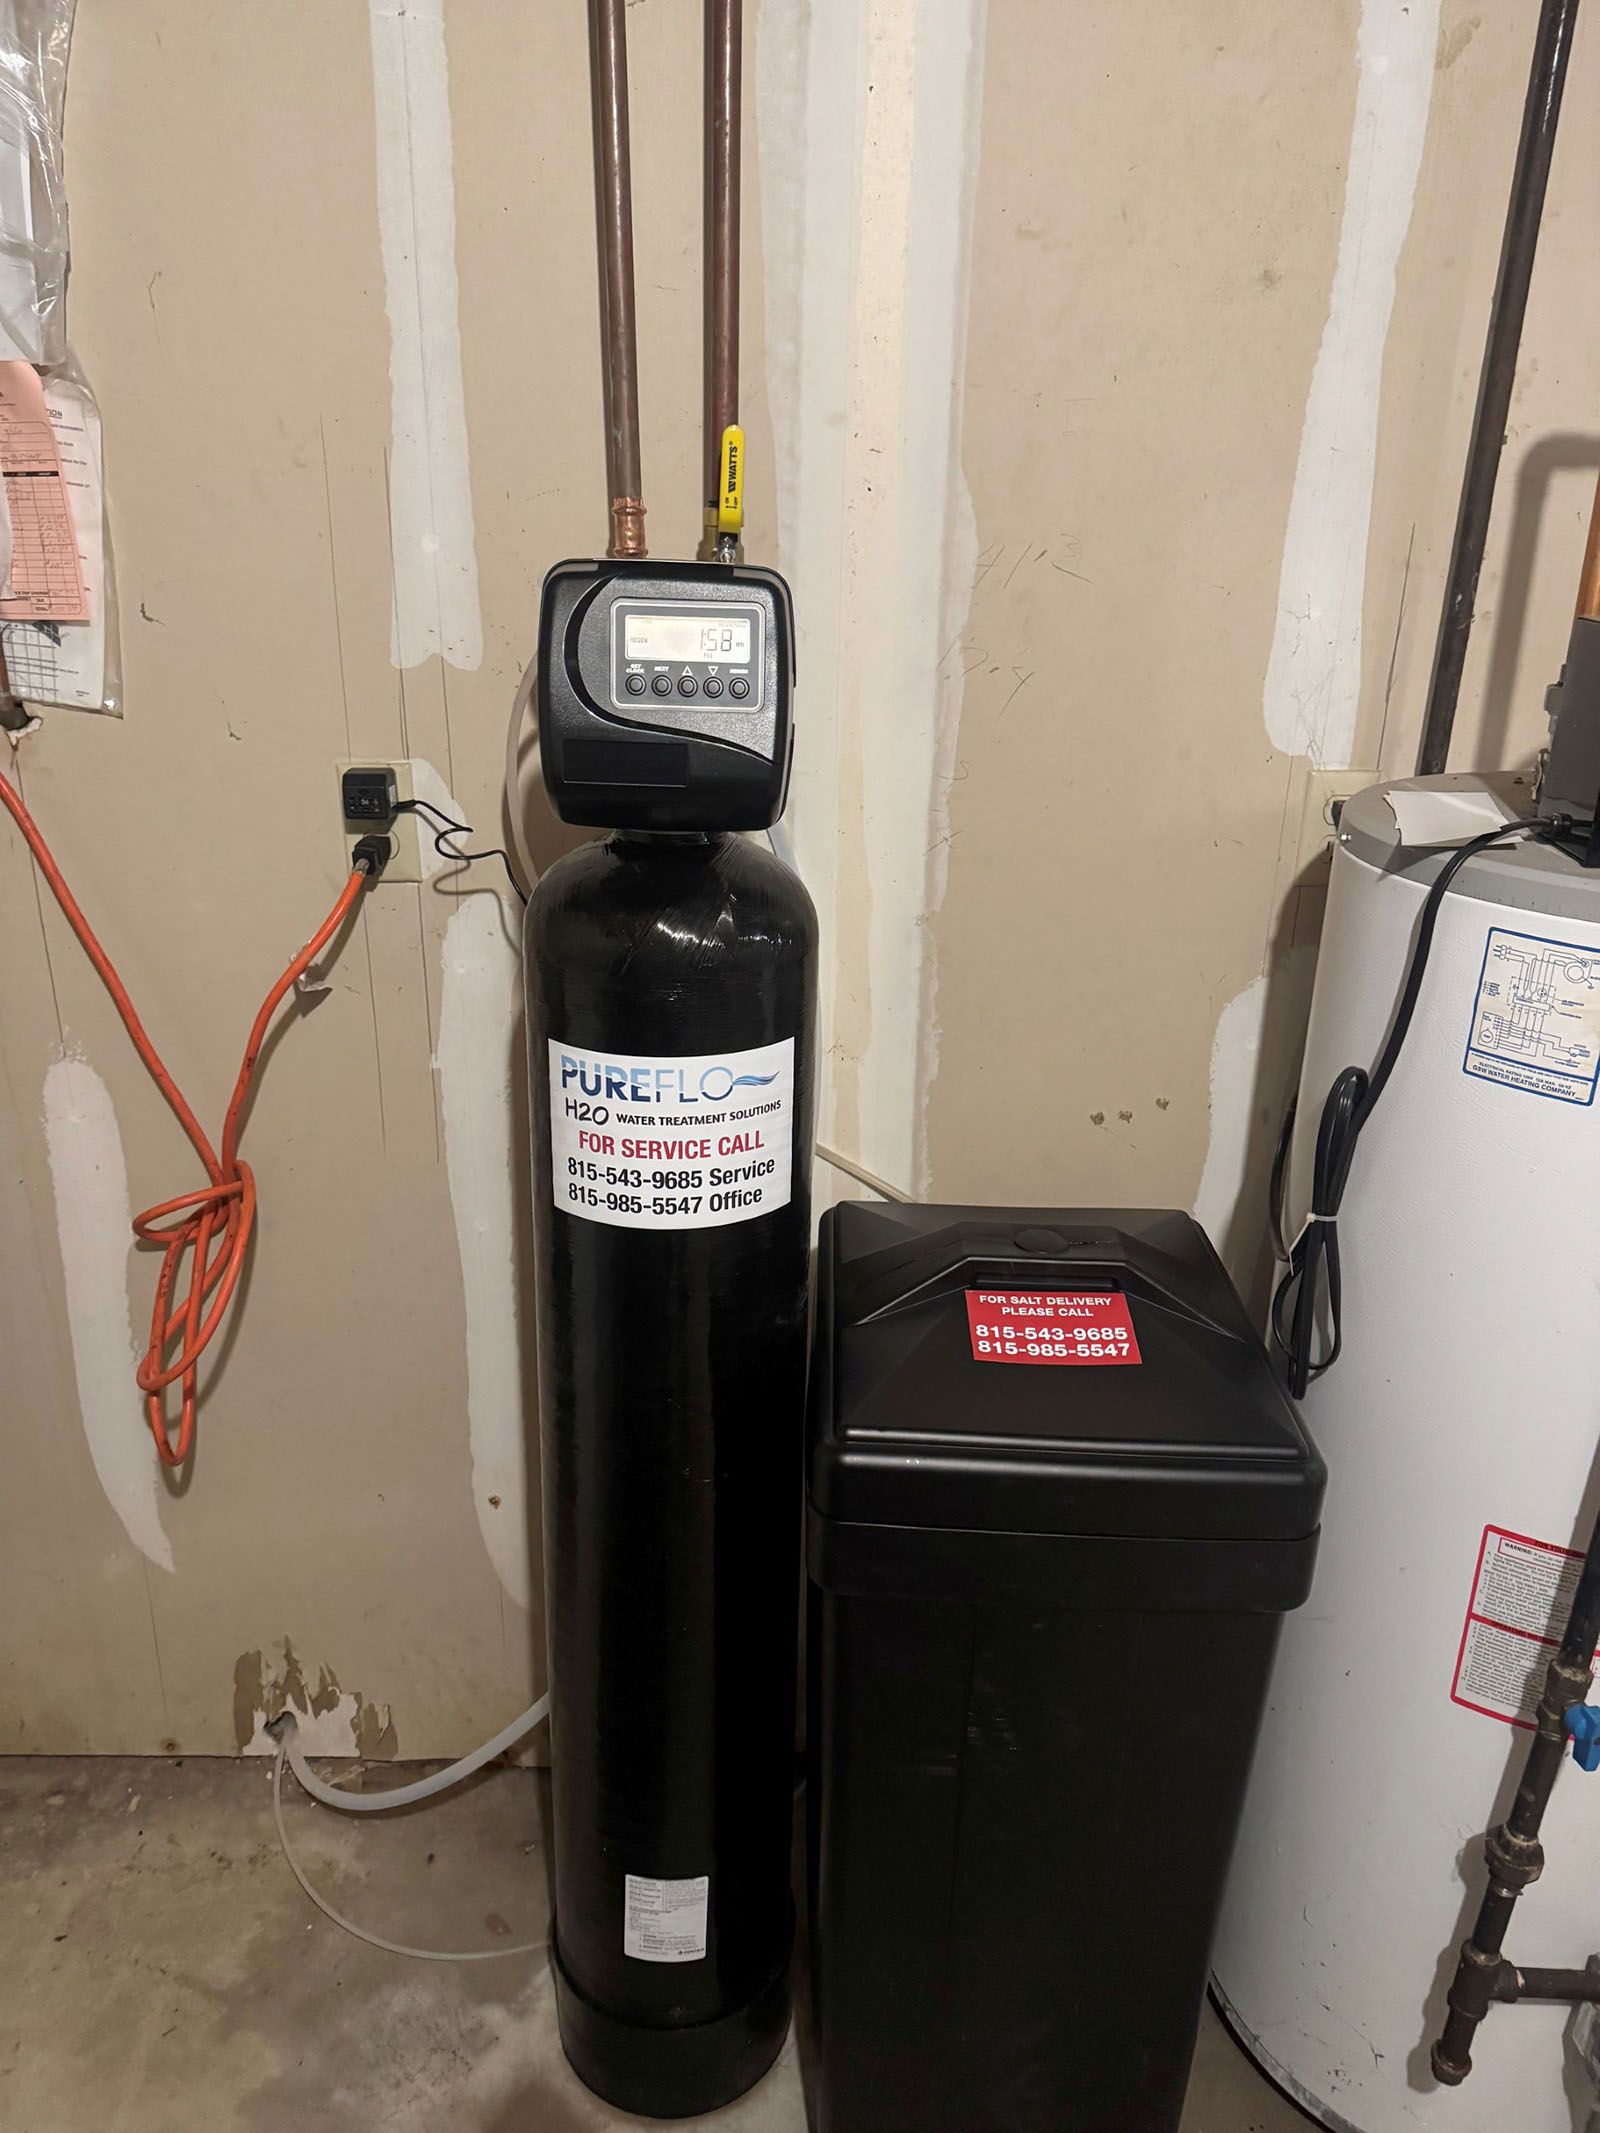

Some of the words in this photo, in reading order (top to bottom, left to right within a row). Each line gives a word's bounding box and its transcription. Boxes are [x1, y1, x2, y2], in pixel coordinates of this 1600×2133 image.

[728, 446, 738, 482] WATTS
[561, 1054, 734, 1102] PUREFLO
[1488, 1068, 1510, 1080] WATER
[1510, 1075, 1540, 1089] HEATING
[1540, 1084, 1576, 1098] COMPANY
[565, 1097, 610, 1126] H2O
[616, 1112, 656, 1126] WATER
[659, 1112, 726, 1126] TREATMENT
[730, 1100, 782, 1121] SOLUTIONS
[579, 1130, 615, 1156] FOR
[622, 1138, 711, 1160] SERVICE
[718, 1130, 764, 1156] CALL
[568, 1157, 703, 1190] 815-543-9685
[709, 1158, 776, 1187] Service
[568, 1184, 702, 1214] 815-985-5547
[709, 1188, 762, 1212] Office
[980, 1295, 1007, 1304] FOR
[1010, 1296, 1042, 1305] SALT
[1046, 1296, 1112, 1306] DELIVERY
[1002, 1306, 1054, 1316] PLEASE
[1058, 1308, 1094, 1317] CALL
[976, 1324, 1128, 1341] 815-543-9685
[978, 1340, 1130, 1358] 815-985-5547
